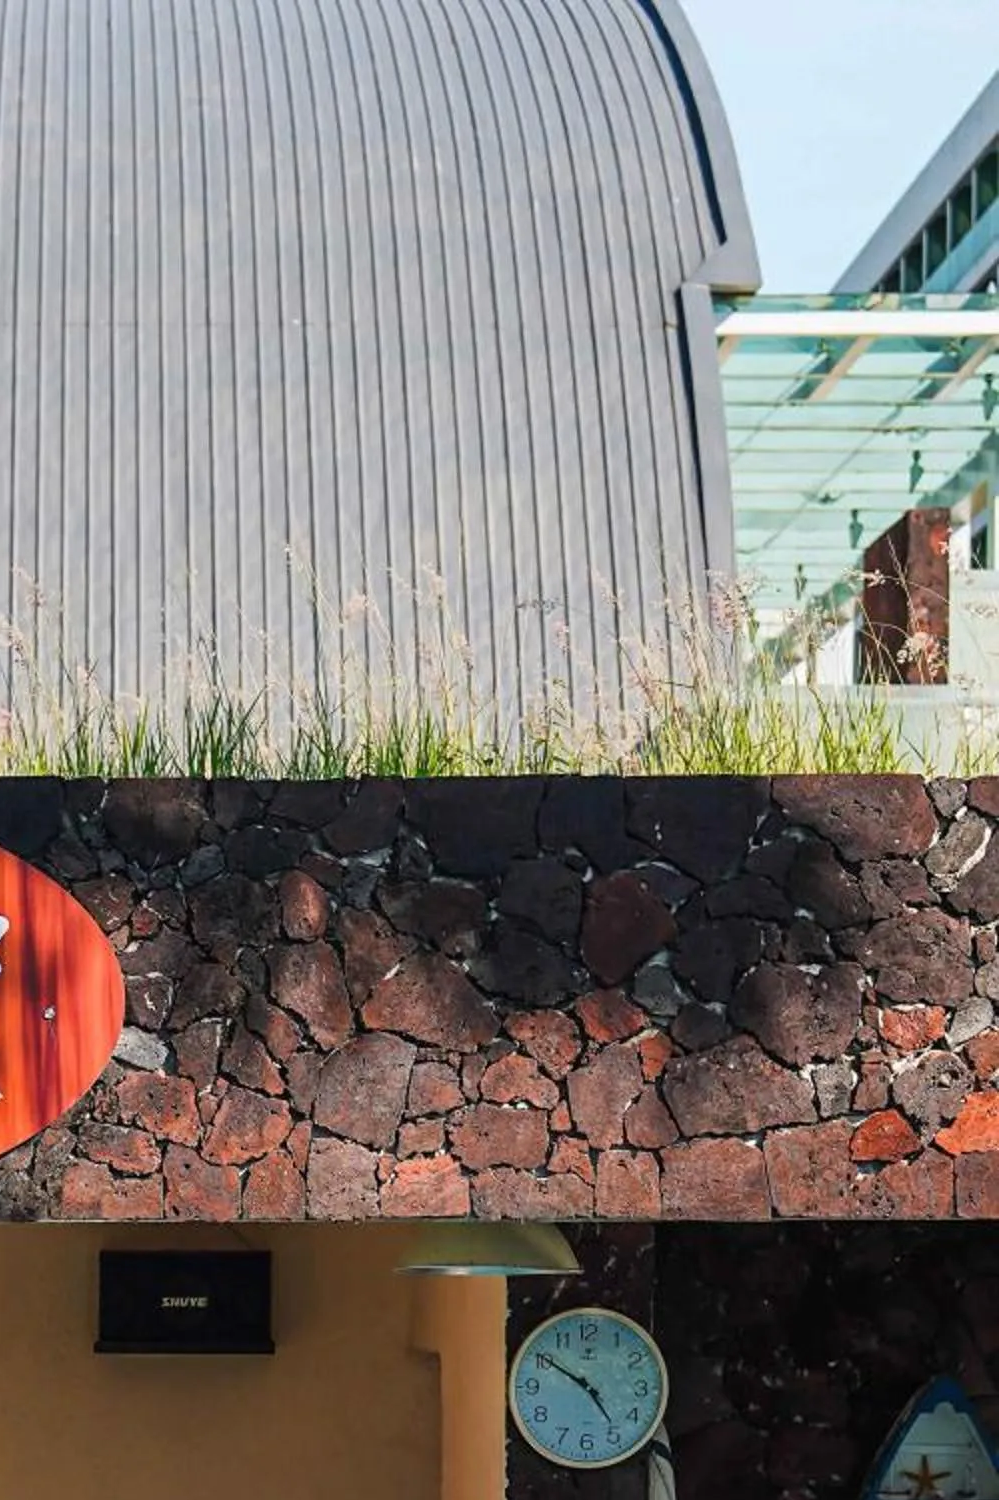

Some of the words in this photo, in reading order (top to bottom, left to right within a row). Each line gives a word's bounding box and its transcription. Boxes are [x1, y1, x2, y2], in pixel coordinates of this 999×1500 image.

[556, 1332, 570, 1349] 11
[579, 1323, 599, 1341] 12
[614, 1332, 621, 1348] 1
[536, 1352, 552, 1370] 10
[628, 1351, 643, 1370] 2
[524, 1378, 540, 1395] 9
[634, 1379, 648, 1397] 3
[534, 1406, 548, 1423] 8
[626, 1407, 639, 1424] 4
[555, 1427, 570, 1445] 7
[579, 1433, 594, 1451] 6
[606, 1425, 621, 1444] 5
